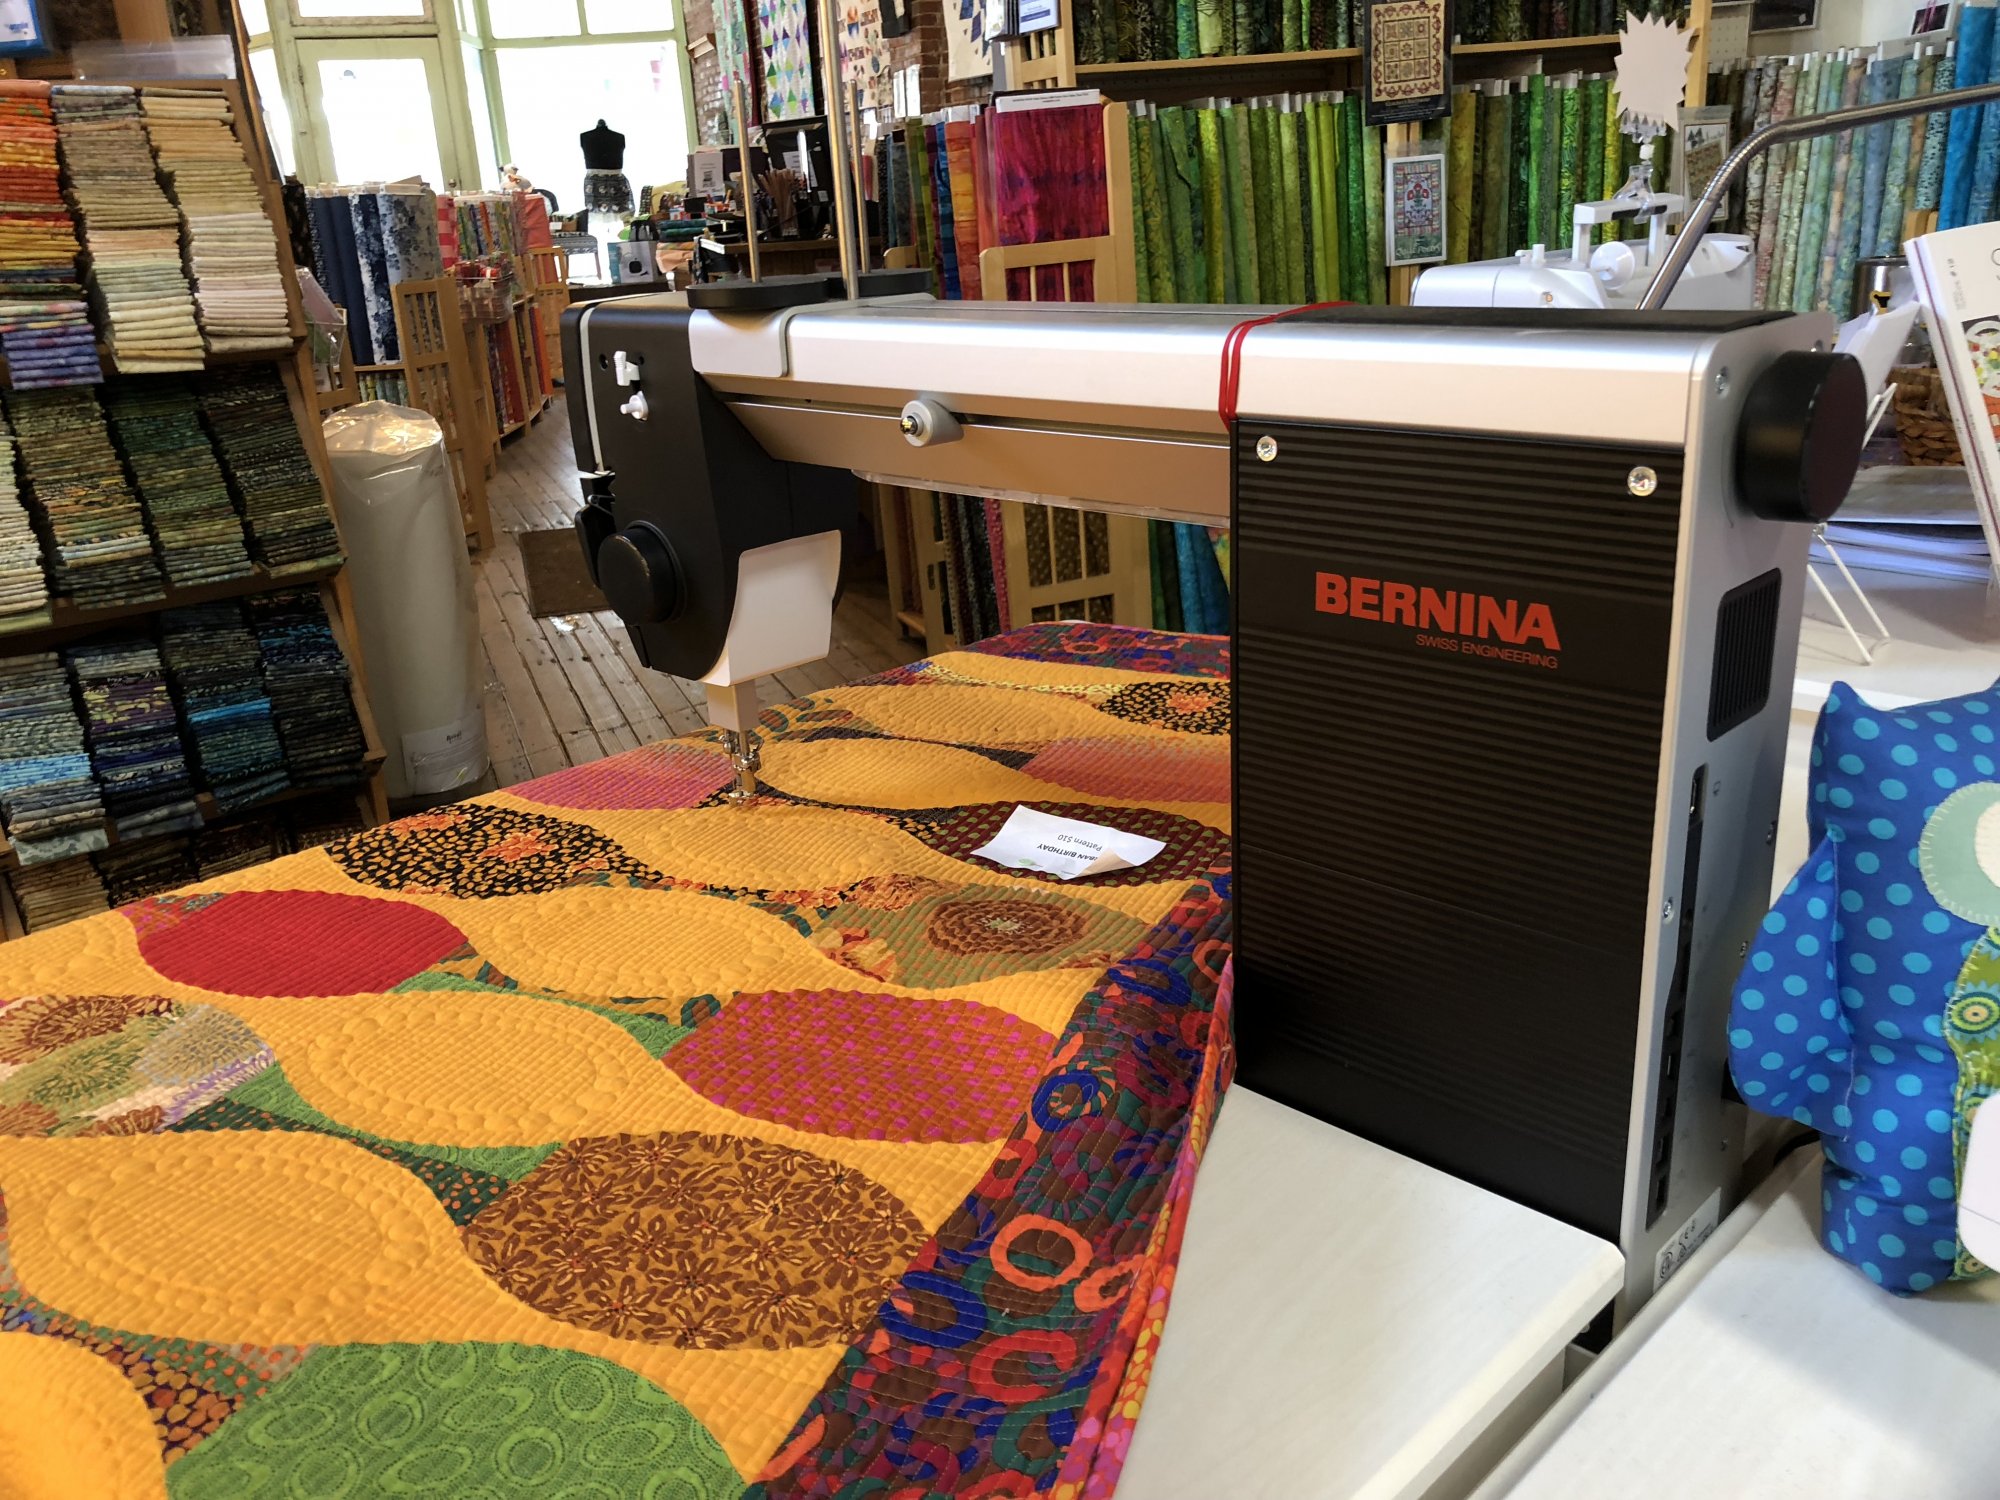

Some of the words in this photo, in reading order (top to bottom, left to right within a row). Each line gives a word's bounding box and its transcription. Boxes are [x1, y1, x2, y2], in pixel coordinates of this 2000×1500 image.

[1315, 571, 1562, 651] BERNINA
[1415, 633, 1459, 651] SWISS
[1461, 641, 1558, 670] ENGINEERING
[1057, 834, 1073, 843] $10
[1073, 837, 1103, 852] Pattern
[1036, 843, 1077, 858] BIRTHDAY
